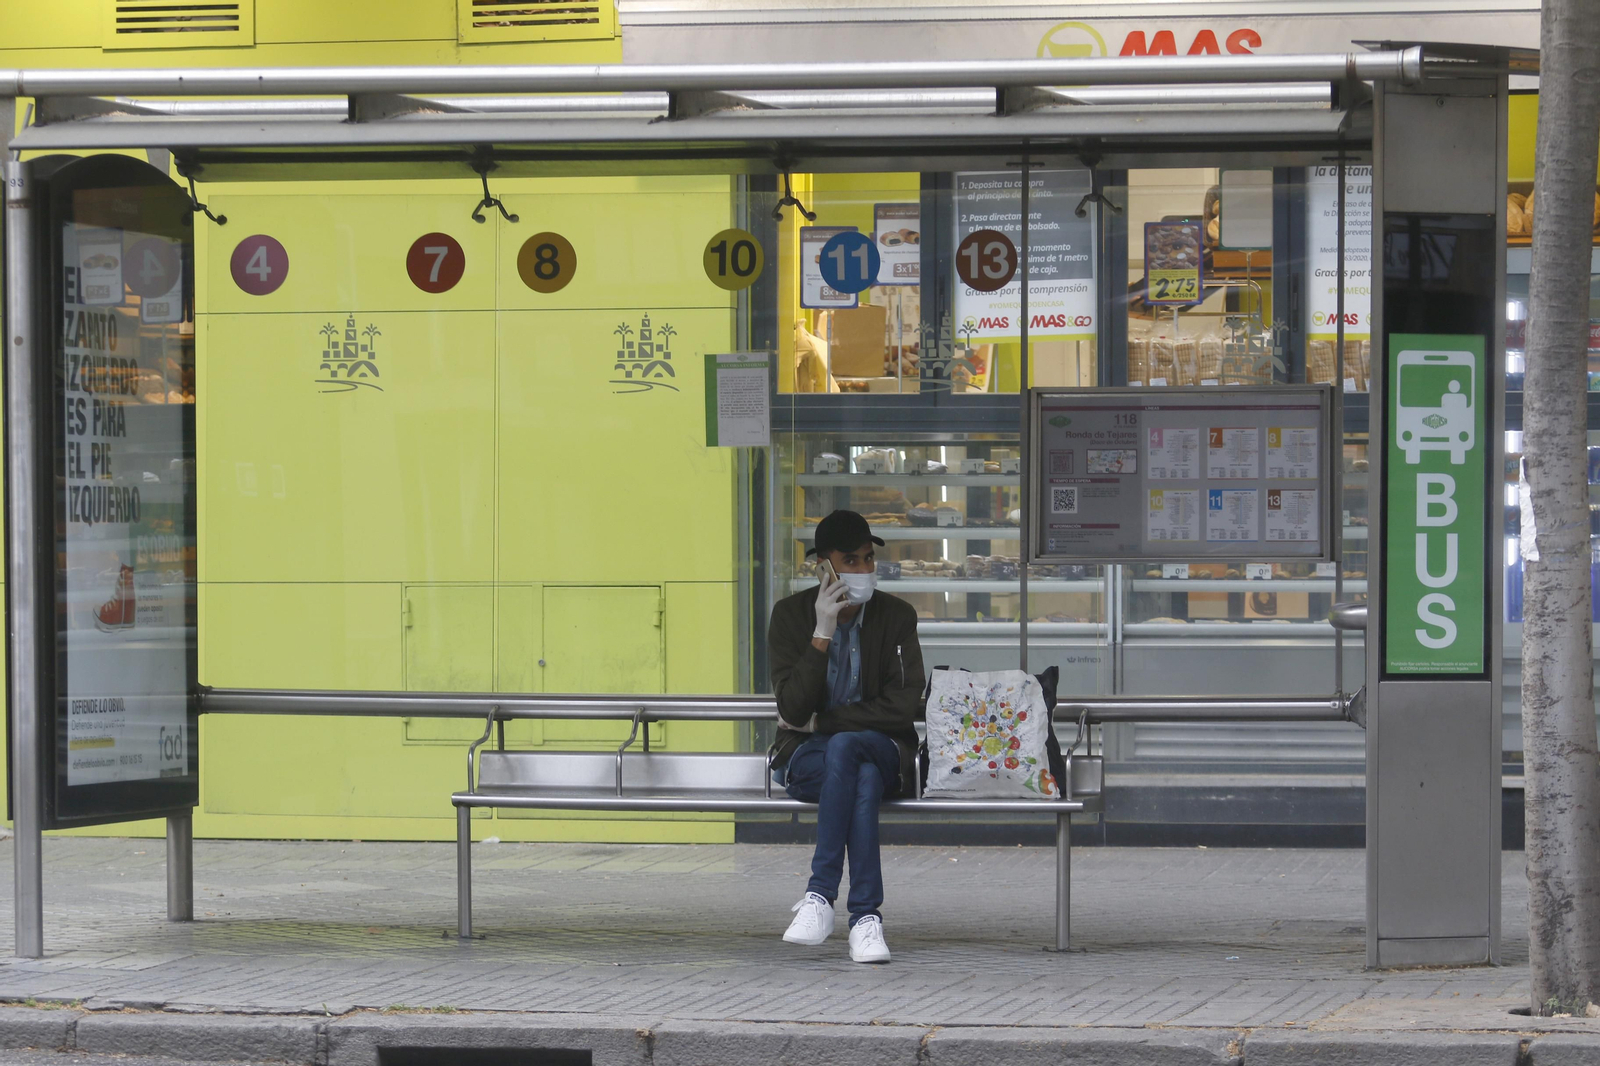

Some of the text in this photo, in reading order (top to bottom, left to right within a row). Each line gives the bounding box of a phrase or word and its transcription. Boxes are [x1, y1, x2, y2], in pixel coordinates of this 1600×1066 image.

[10, 178, 24, 187] 93
[968, 180, 1003, 190] Deposita
[968, 192, 975, 200] al
[976, 191, 1010, 202] principio
[961, 212, 1042, 222] 2. Pasa directamnte
[1004, 223, 1014, 231] de
[1032, 244, 1071, 252] momento
[245, 245, 271, 282] 4
[534, 243, 560, 280] 8
[710, 240, 757, 278] 10
[828, 244, 868, 280] 11
[962, 241, 1010, 279] 13
[1046, 254, 1056, 262] de
[1058, 254, 1062, 262] 1
[1064, 254, 1089, 262] metro
[423, 246, 450, 283] 7
[1029, 265, 1039, 274] de
[1040, 266, 1059, 275] caja.
[1350, 270, 1366, 279] por
[999, 288, 1017, 297] por
[1029, 284, 1088, 296] comprensión
[978, 317, 1009, 329] MAS
[67, 398, 126, 438] ES PARA
[1114, 413, 1137, 425] 118
[1107, 431, 1137, 440] Tejares
[1151, 431, 1159, 442] 4
[1210, 432, 1218, 443] 7
[1269, 432, 1276, 443] 8
[68, 441, 113, 480] EL PIE
[69, 485, 141, 527] IZQUIERDO
[1151, 495, 1163, 506] 10
[1209, 496, 1221, 506] 11
[1268, 495, 1280, 506] 13
[1415, 473, 1459, 649] BUS
[72, 699, 98, 715] DEFIENDE
[99, 699, 108, 714] LO
[159, 725, 183, 762] fad
